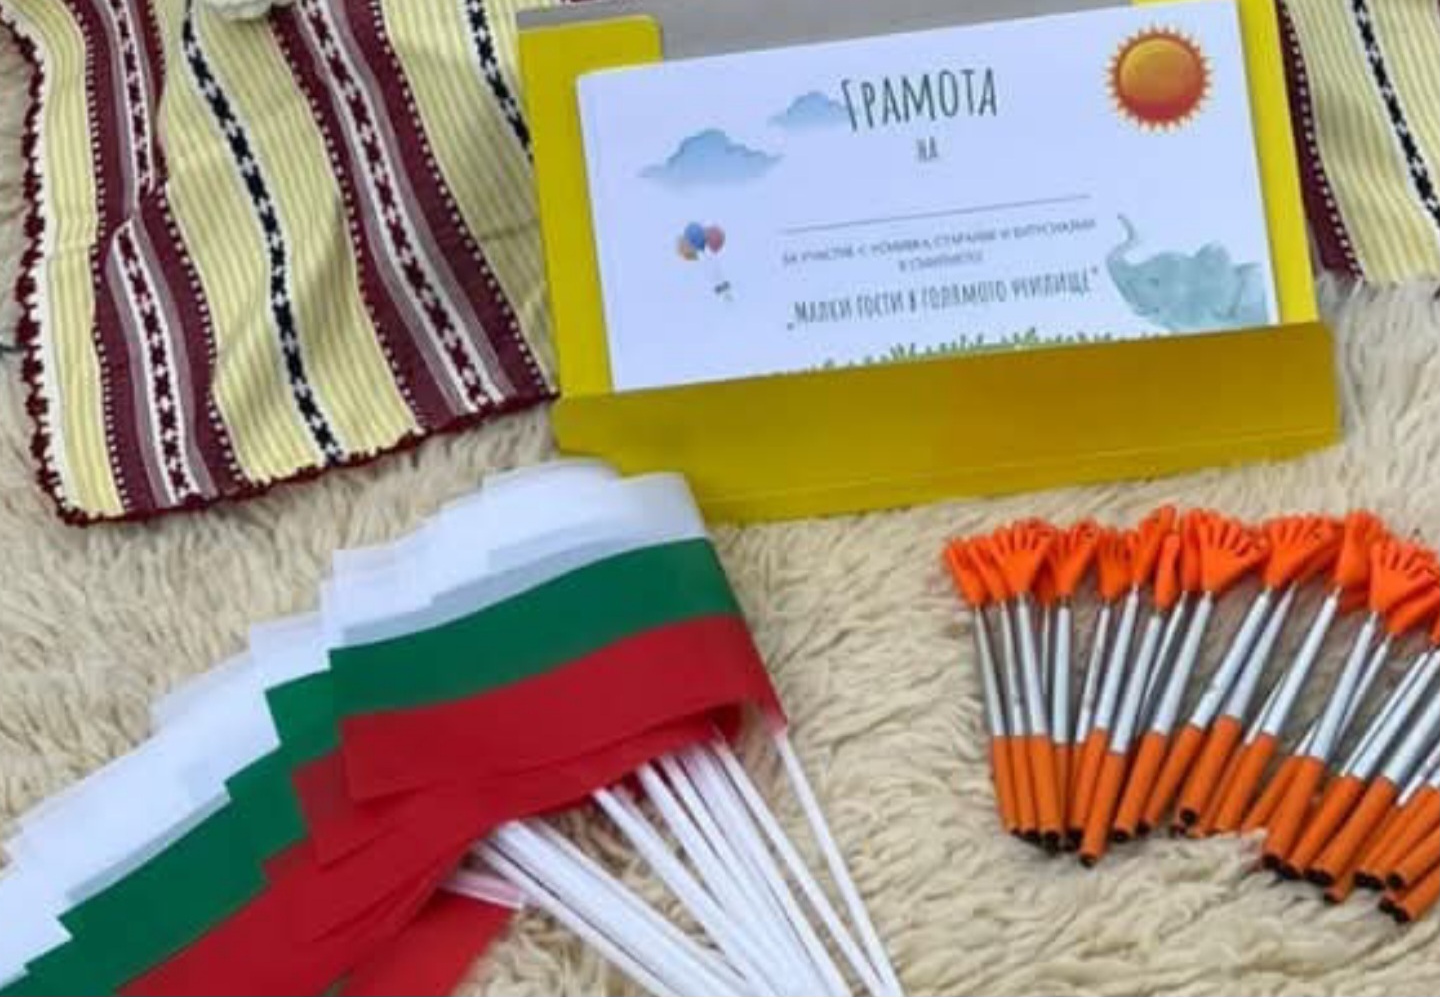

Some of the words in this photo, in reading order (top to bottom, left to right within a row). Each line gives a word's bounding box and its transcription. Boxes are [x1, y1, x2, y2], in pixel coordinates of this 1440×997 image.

[840, 67, 998, 132] ГРАМОТА
[916, 136, 938, 162] НА
[856, 288, 904, 319] ГОСТИ
[921, 280, 1008, 310] ГОЛЯМОТО
